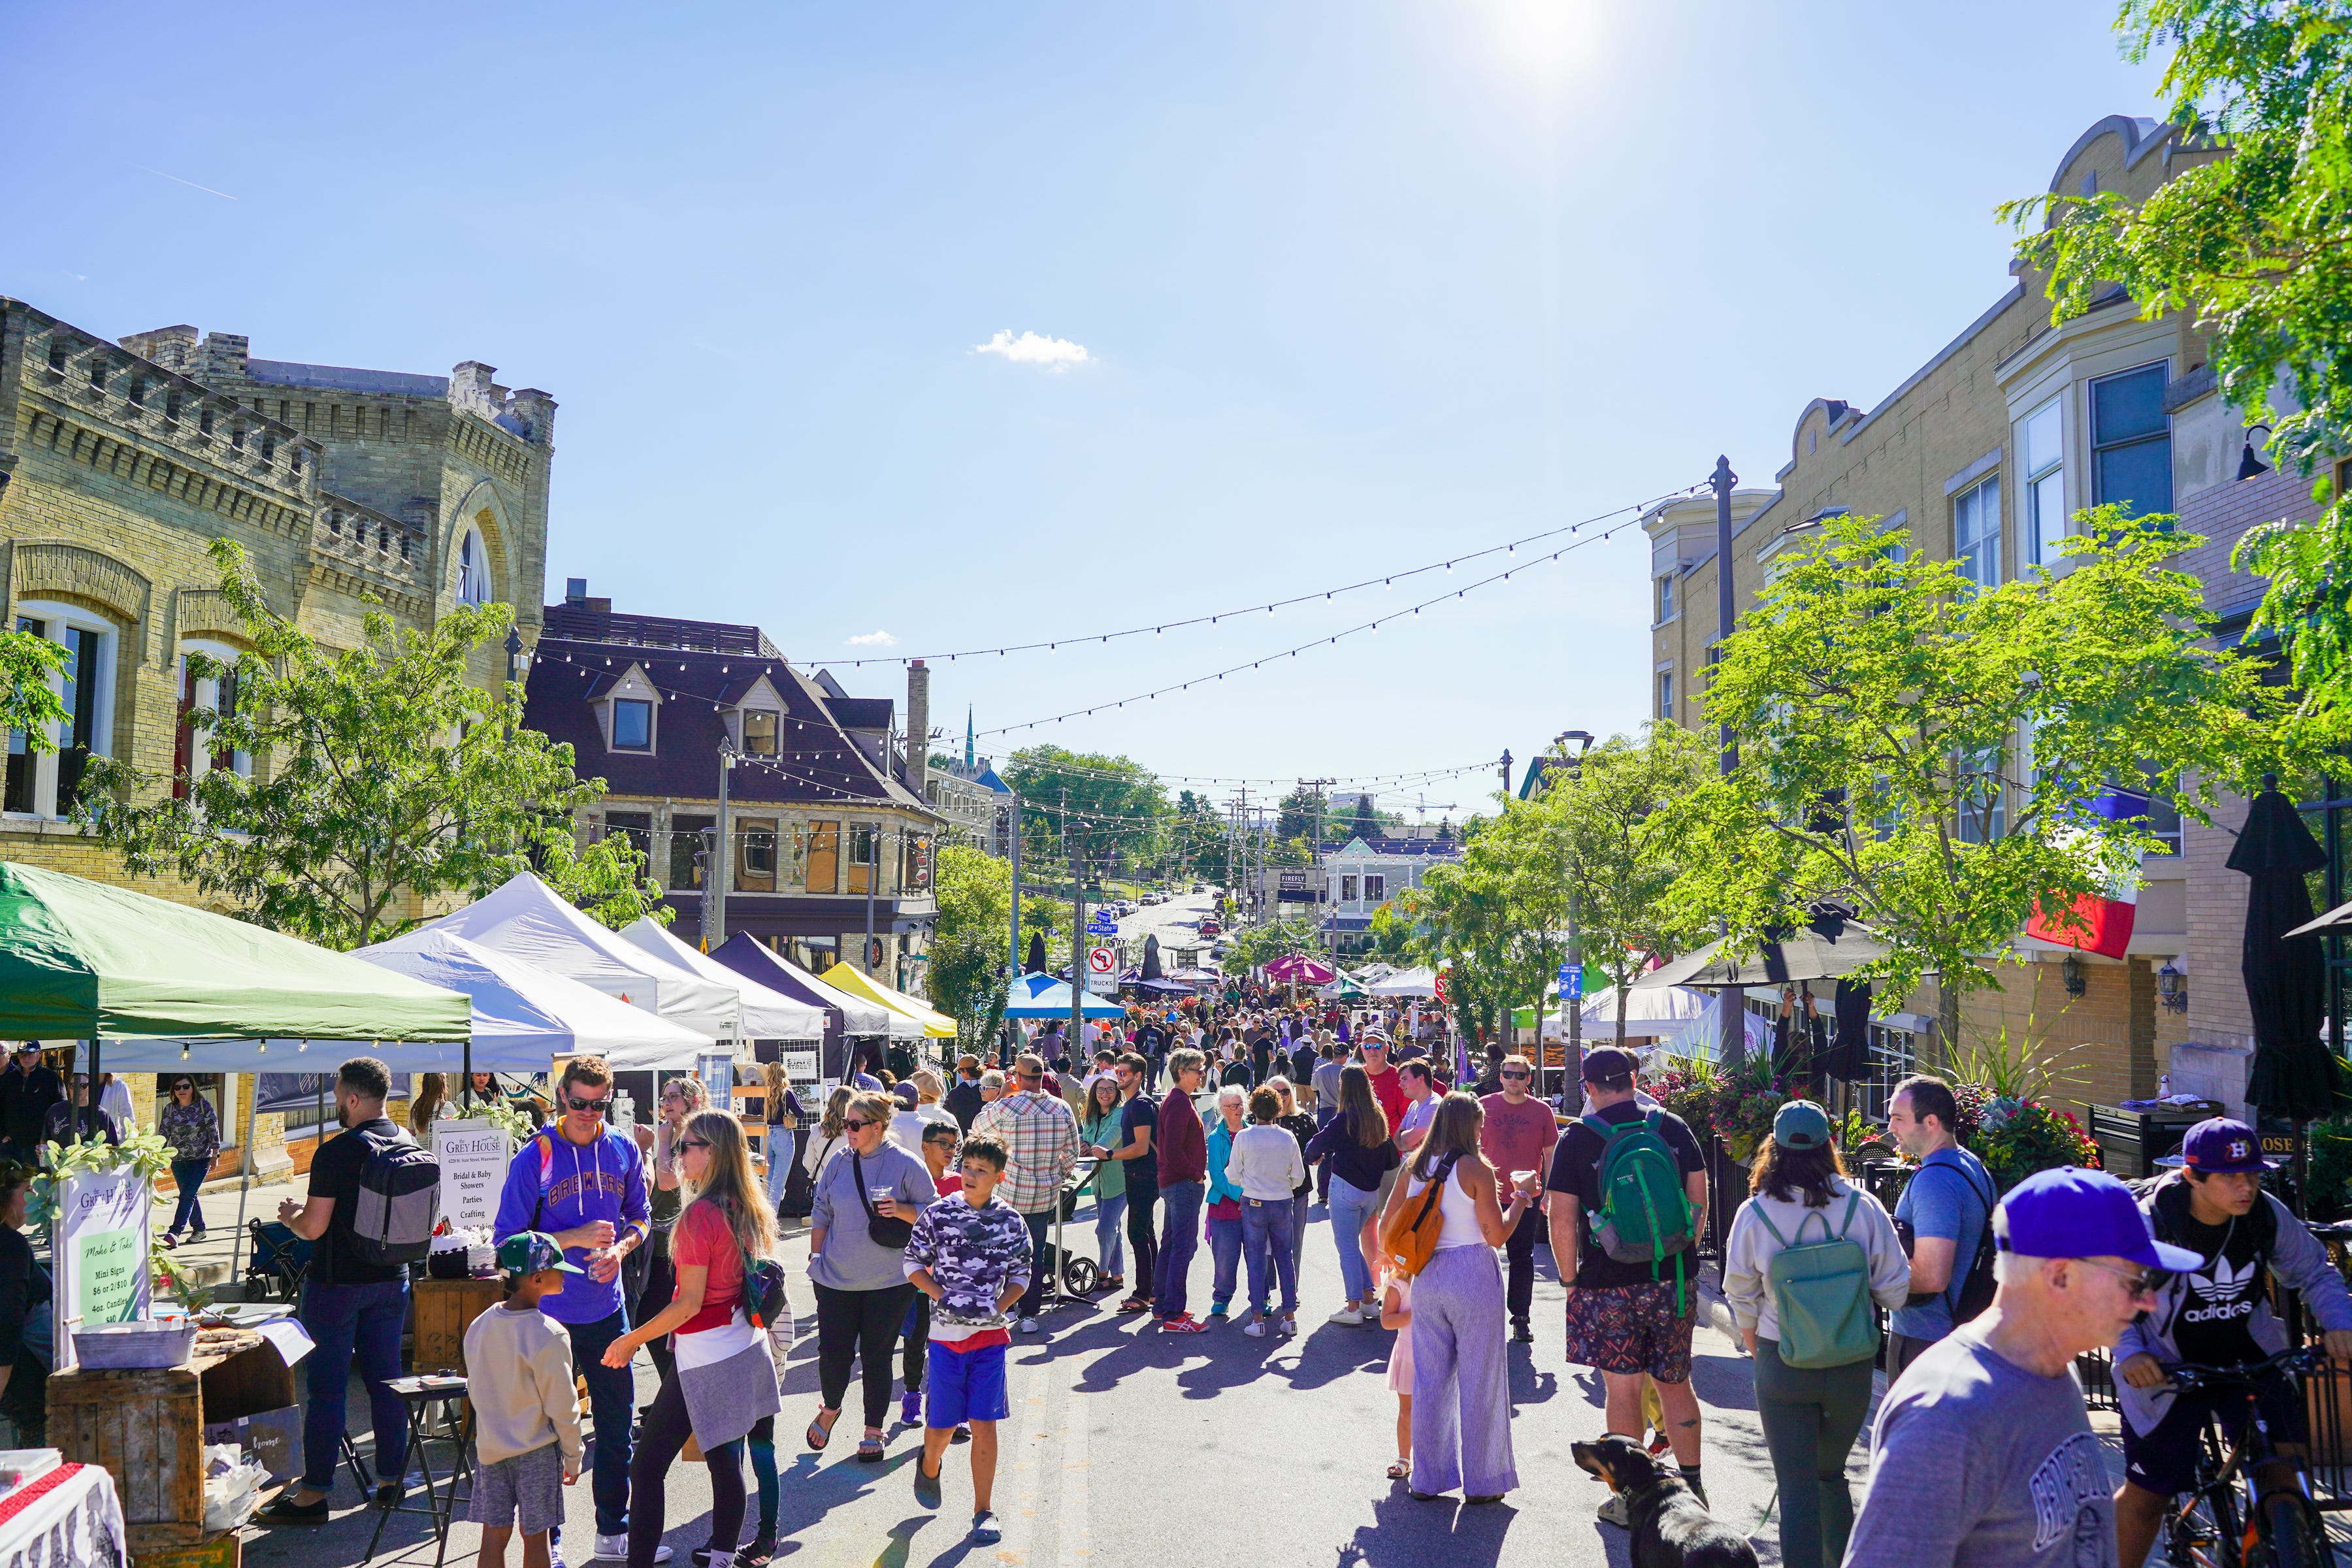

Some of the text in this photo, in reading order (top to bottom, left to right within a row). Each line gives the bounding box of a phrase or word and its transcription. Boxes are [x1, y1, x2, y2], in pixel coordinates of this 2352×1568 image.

[446, 1140, 500, 1153] GREY HOUSE
[2230, 1142, 2247, 1158] H
[453, 1171, 470, 1180] Bridal
[478, 1170, 492, 1179] Baby
[549, 1171, 625, 1207] BREWERS
[461, 1210, 485, 1218] Crafting
[85, 1237, 133, 1259] Make & Take
[95, 1266, 125, 1280] Mini Signs
[93, 1286, 101, 1296] $6
[110, 1279, 127, 1291] 2/$10
[92, 1298, 128, 1313] 4oz. Candles
[2184, 1300, 2253, 1322] adidas
[253, 1436, 280, 1449] home
